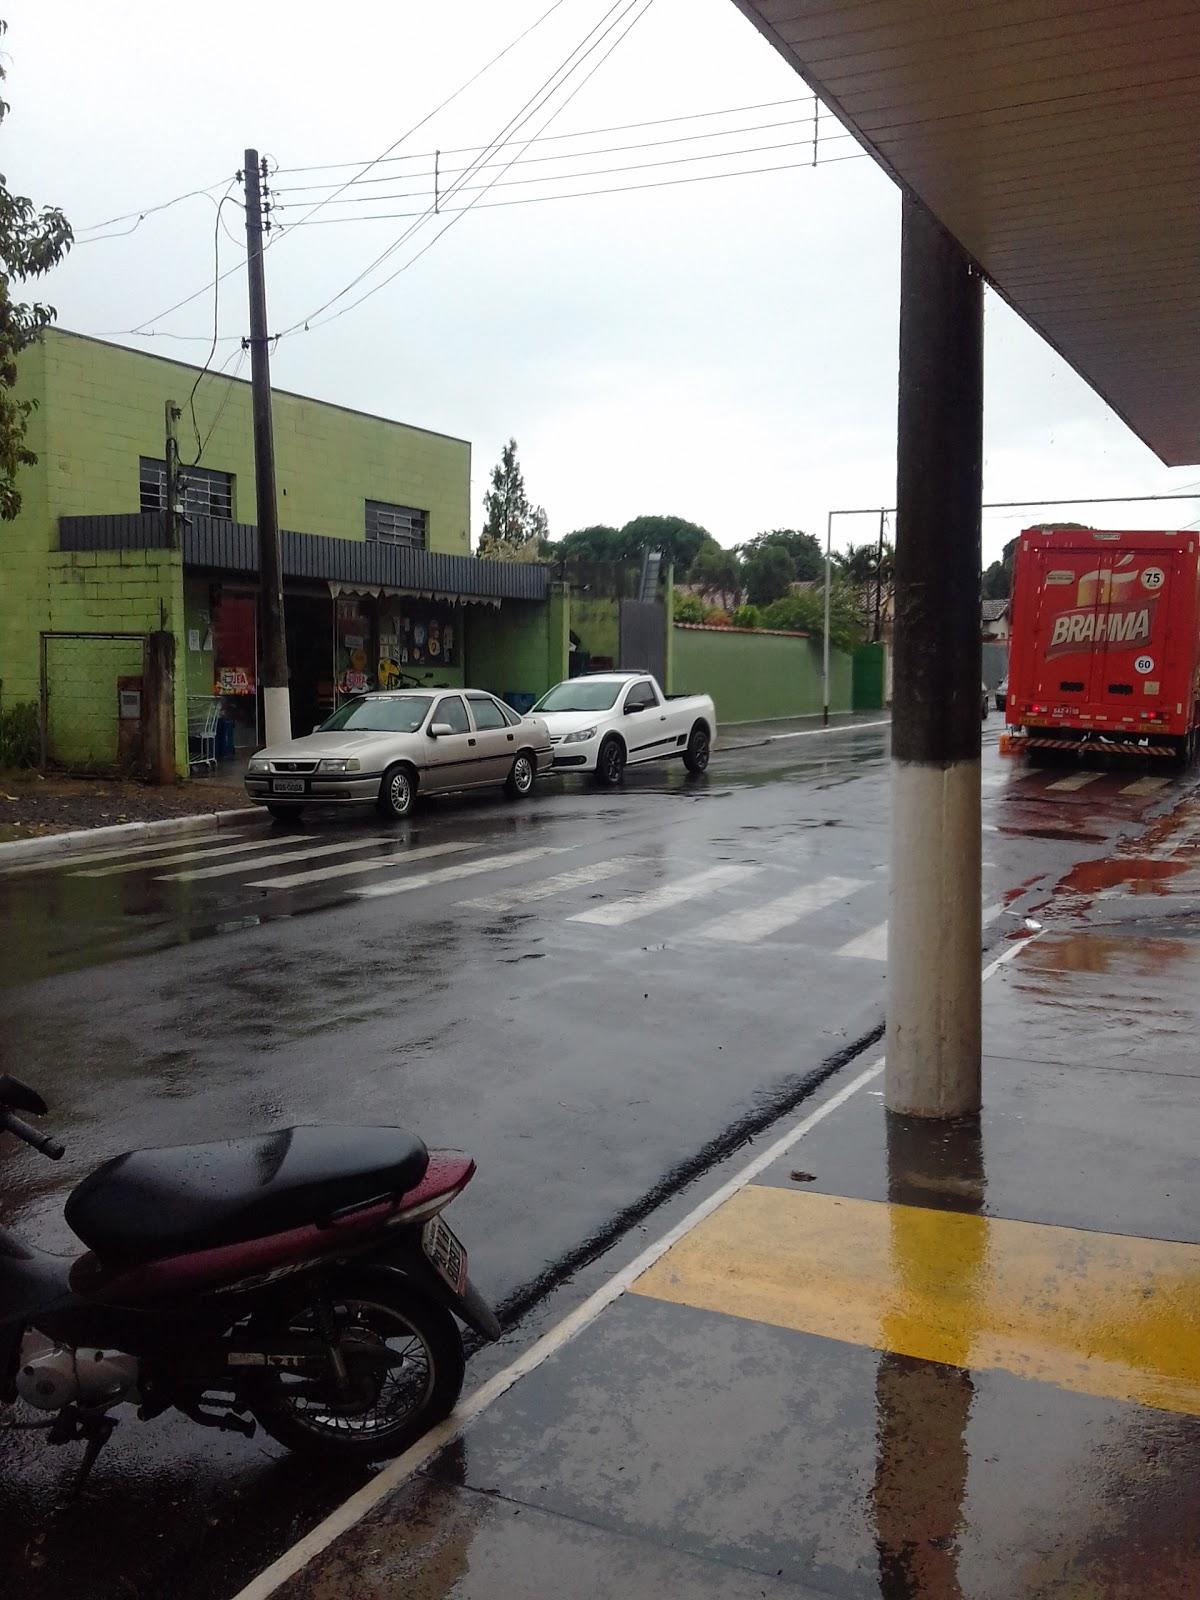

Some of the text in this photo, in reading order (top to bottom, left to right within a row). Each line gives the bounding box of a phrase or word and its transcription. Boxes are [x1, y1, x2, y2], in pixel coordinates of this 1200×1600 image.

[1145, 573, 1161, 584] 75
[1051, 608, 1149, 647] BRAHMA
[1138, 660, 1151, 669] 60
